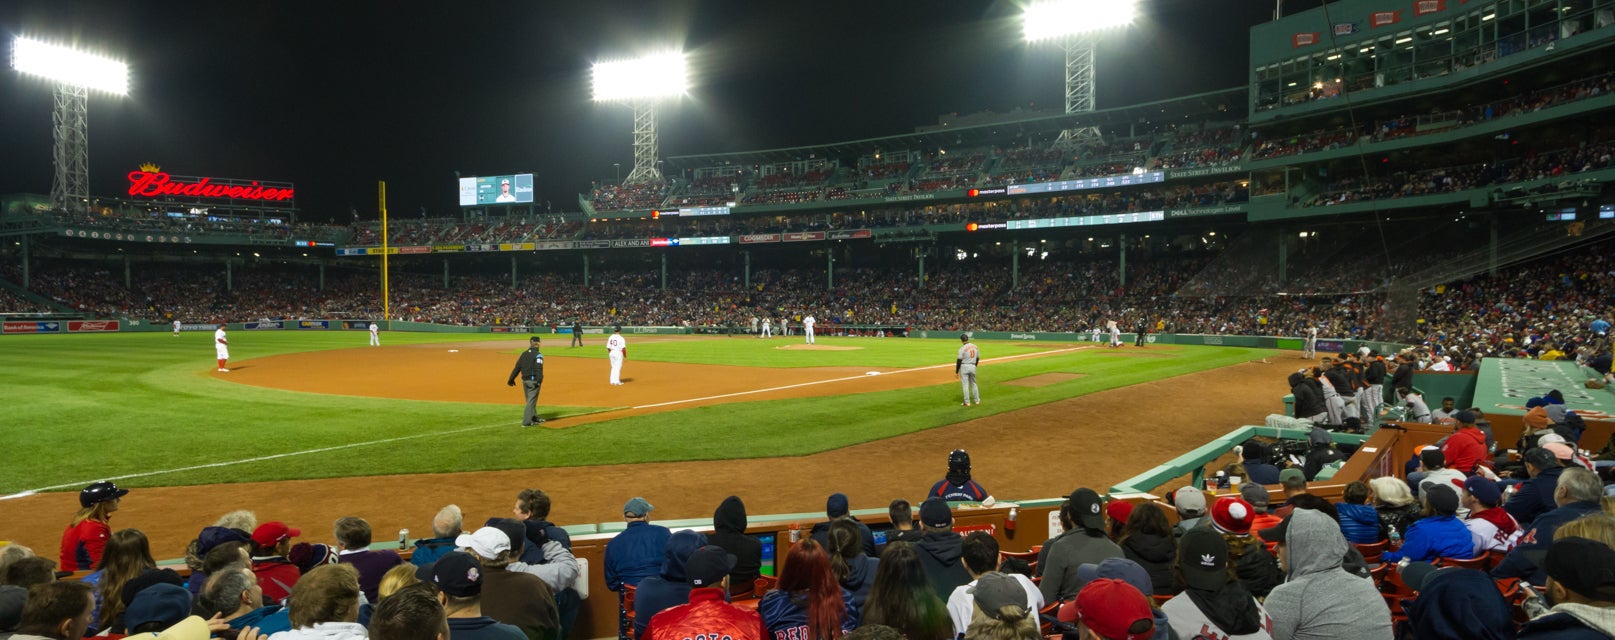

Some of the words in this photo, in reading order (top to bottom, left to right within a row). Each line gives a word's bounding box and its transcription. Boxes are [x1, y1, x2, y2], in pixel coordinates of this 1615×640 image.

[1211, 165, 1240, 174] PAVILION
[128, 171, 294, 200] Budweiser
[1188, 207, 1223, 215] Technologies
[610, 339, 618, 347] 40
